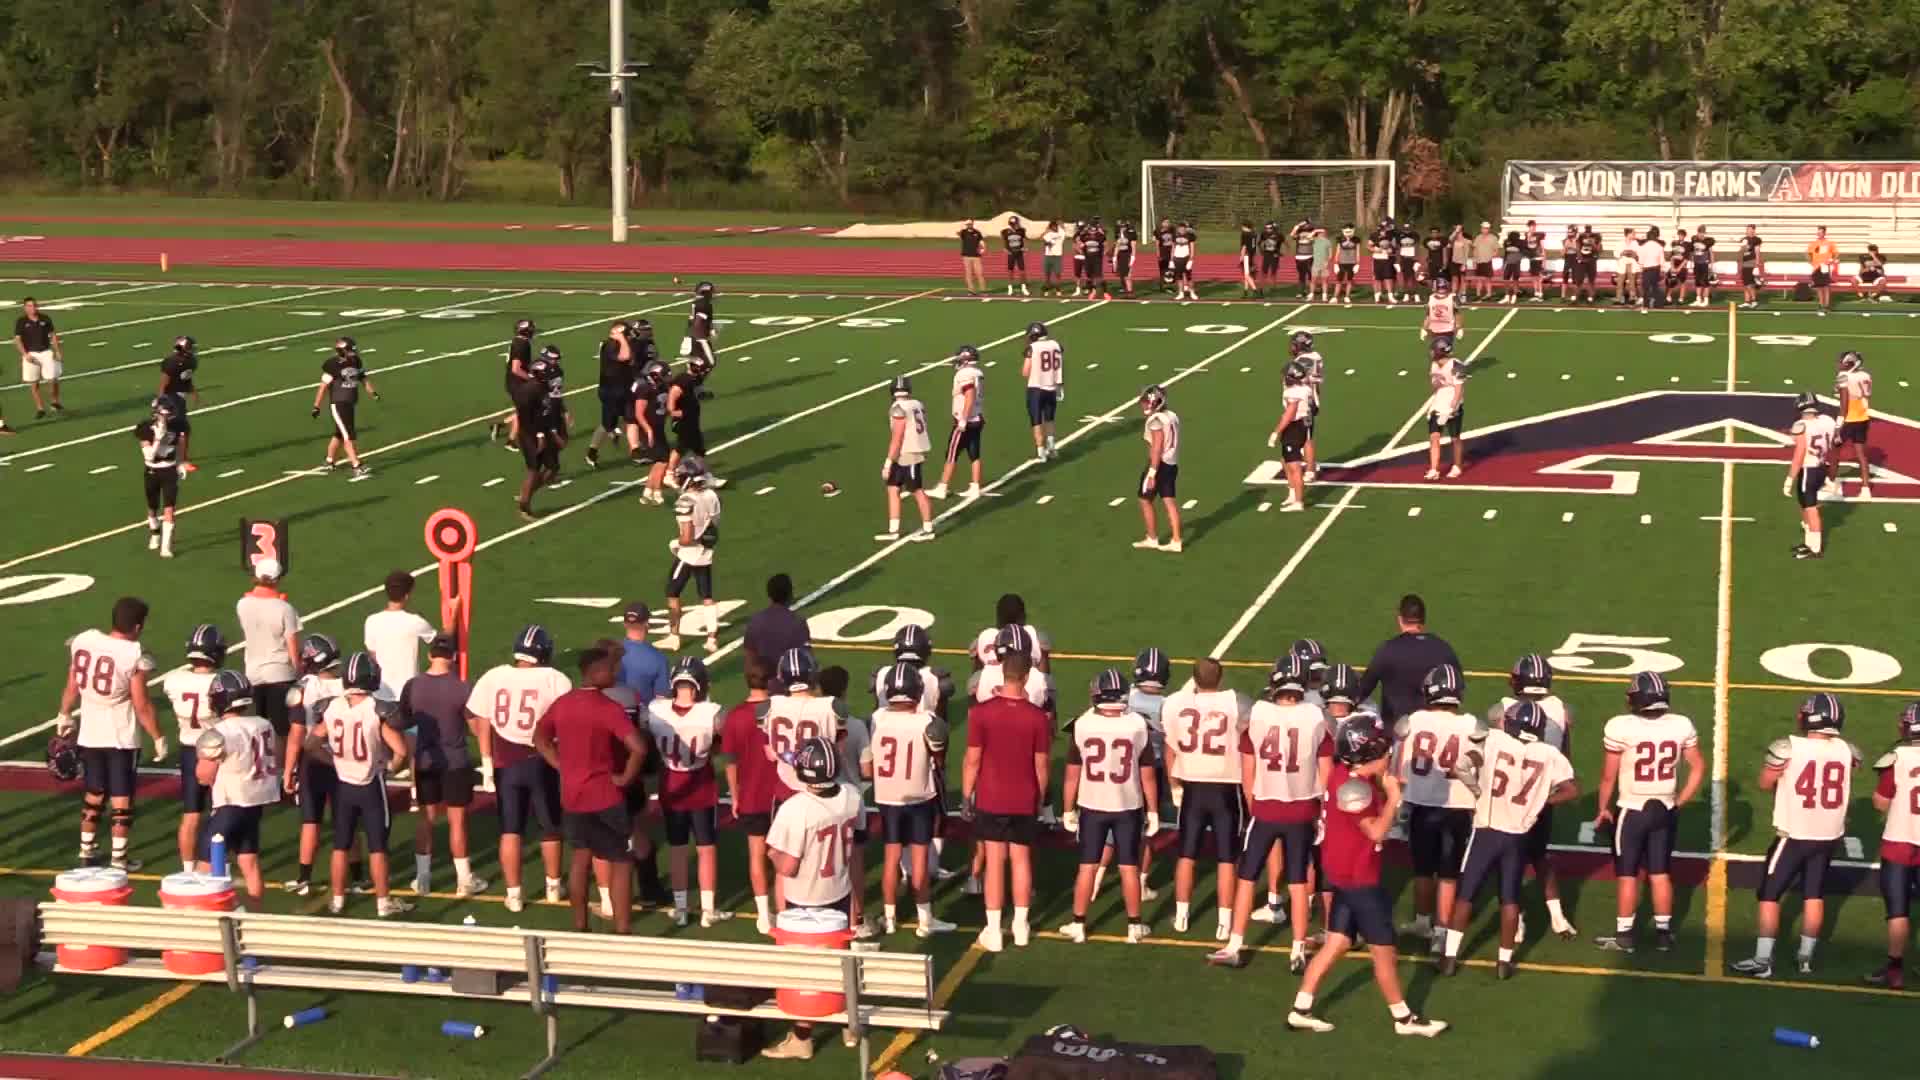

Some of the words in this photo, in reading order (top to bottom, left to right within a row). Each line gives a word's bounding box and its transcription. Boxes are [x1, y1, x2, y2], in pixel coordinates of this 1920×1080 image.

[1564, 170, 1622, 197] AVON
[1632, 170, 1674, 197] OLD
[1685, 171, 1761, 197] FARMS
[1809, 171, 1872, 198] AVON
[1041, 350, 1061, 372] 86
[251, 523, 277, 567] 3
[74, 649, 115, 696] 88
[495, 688, 537, 731] 85
[1177, 708, 1228, 756] 32
[878, 735, 914, 780] 31
[1082, 737, 1134, 784] 23
[1260, 725, 1300, 773] 41
[1411, 730, 1460, 777] 84
[1634, 740, 1677, 783] 22
[1794, 759, 1845, 810] 48
